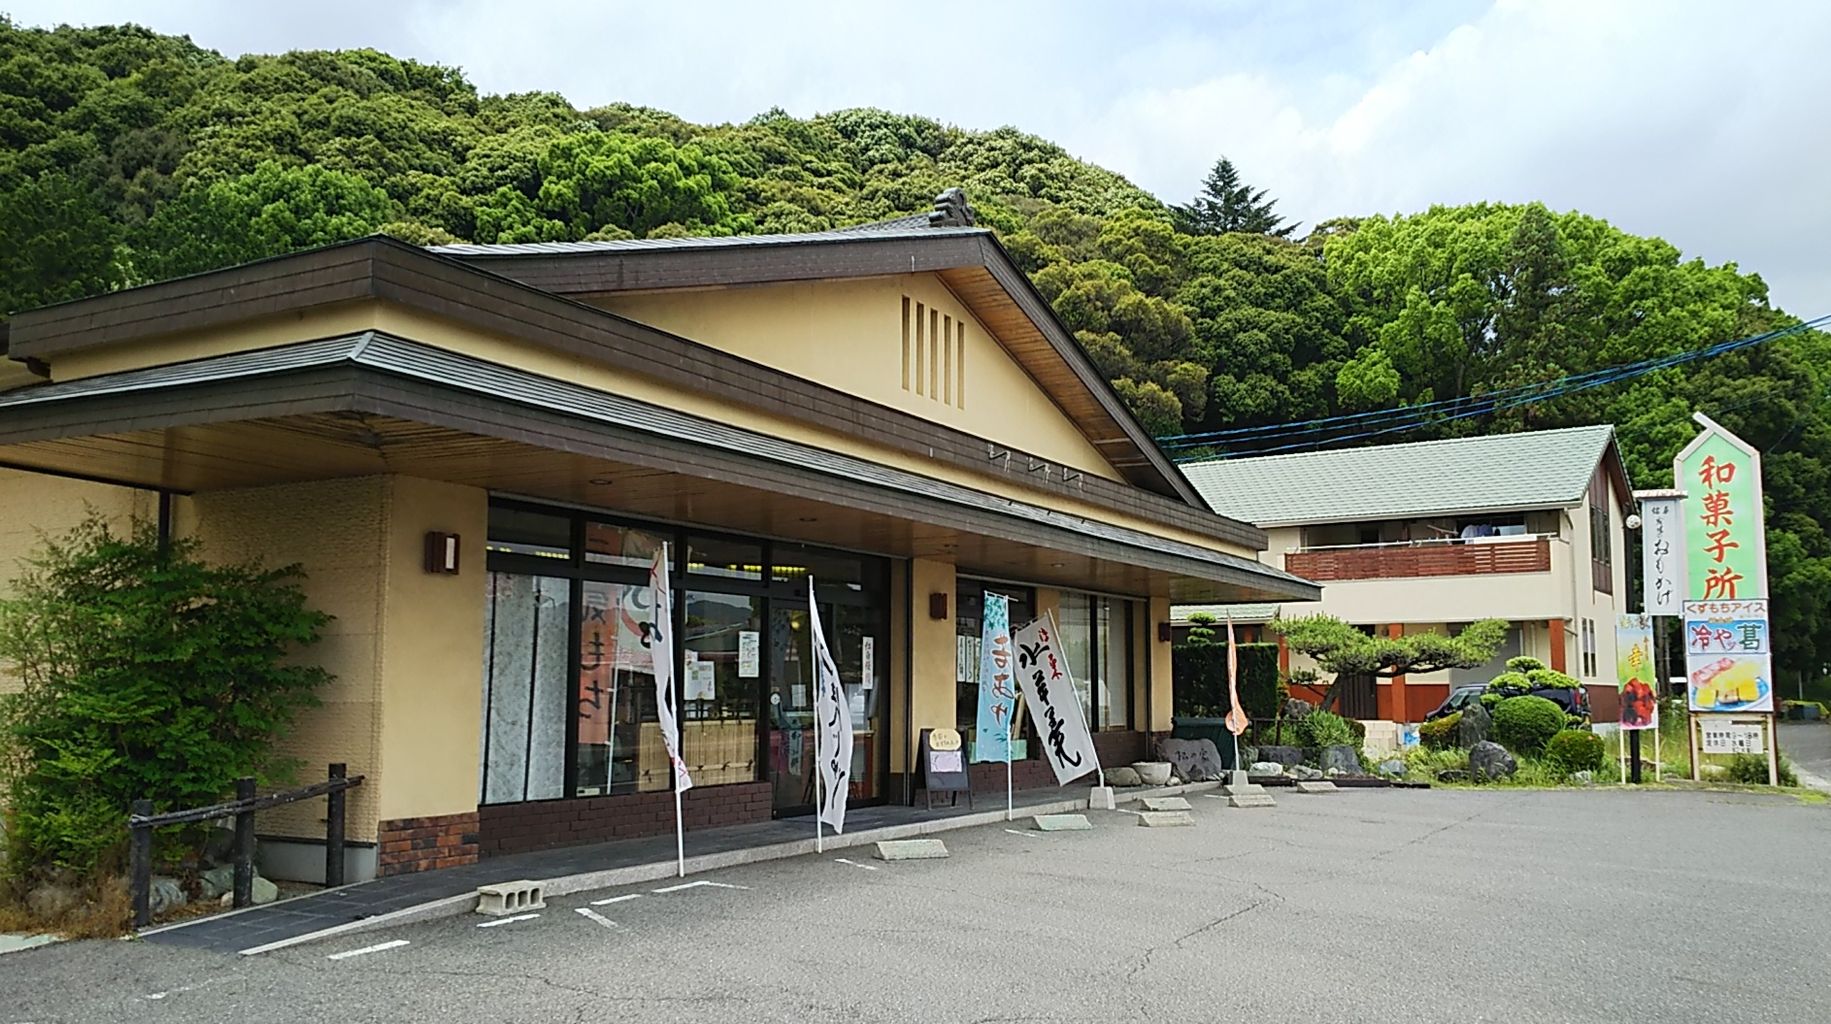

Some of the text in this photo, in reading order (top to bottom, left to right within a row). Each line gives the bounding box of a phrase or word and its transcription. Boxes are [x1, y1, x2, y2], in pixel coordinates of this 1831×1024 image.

[1698, 455, 1744, 600] 和菓子所
[1686, 602, 1766, 614] くずもちアイス
